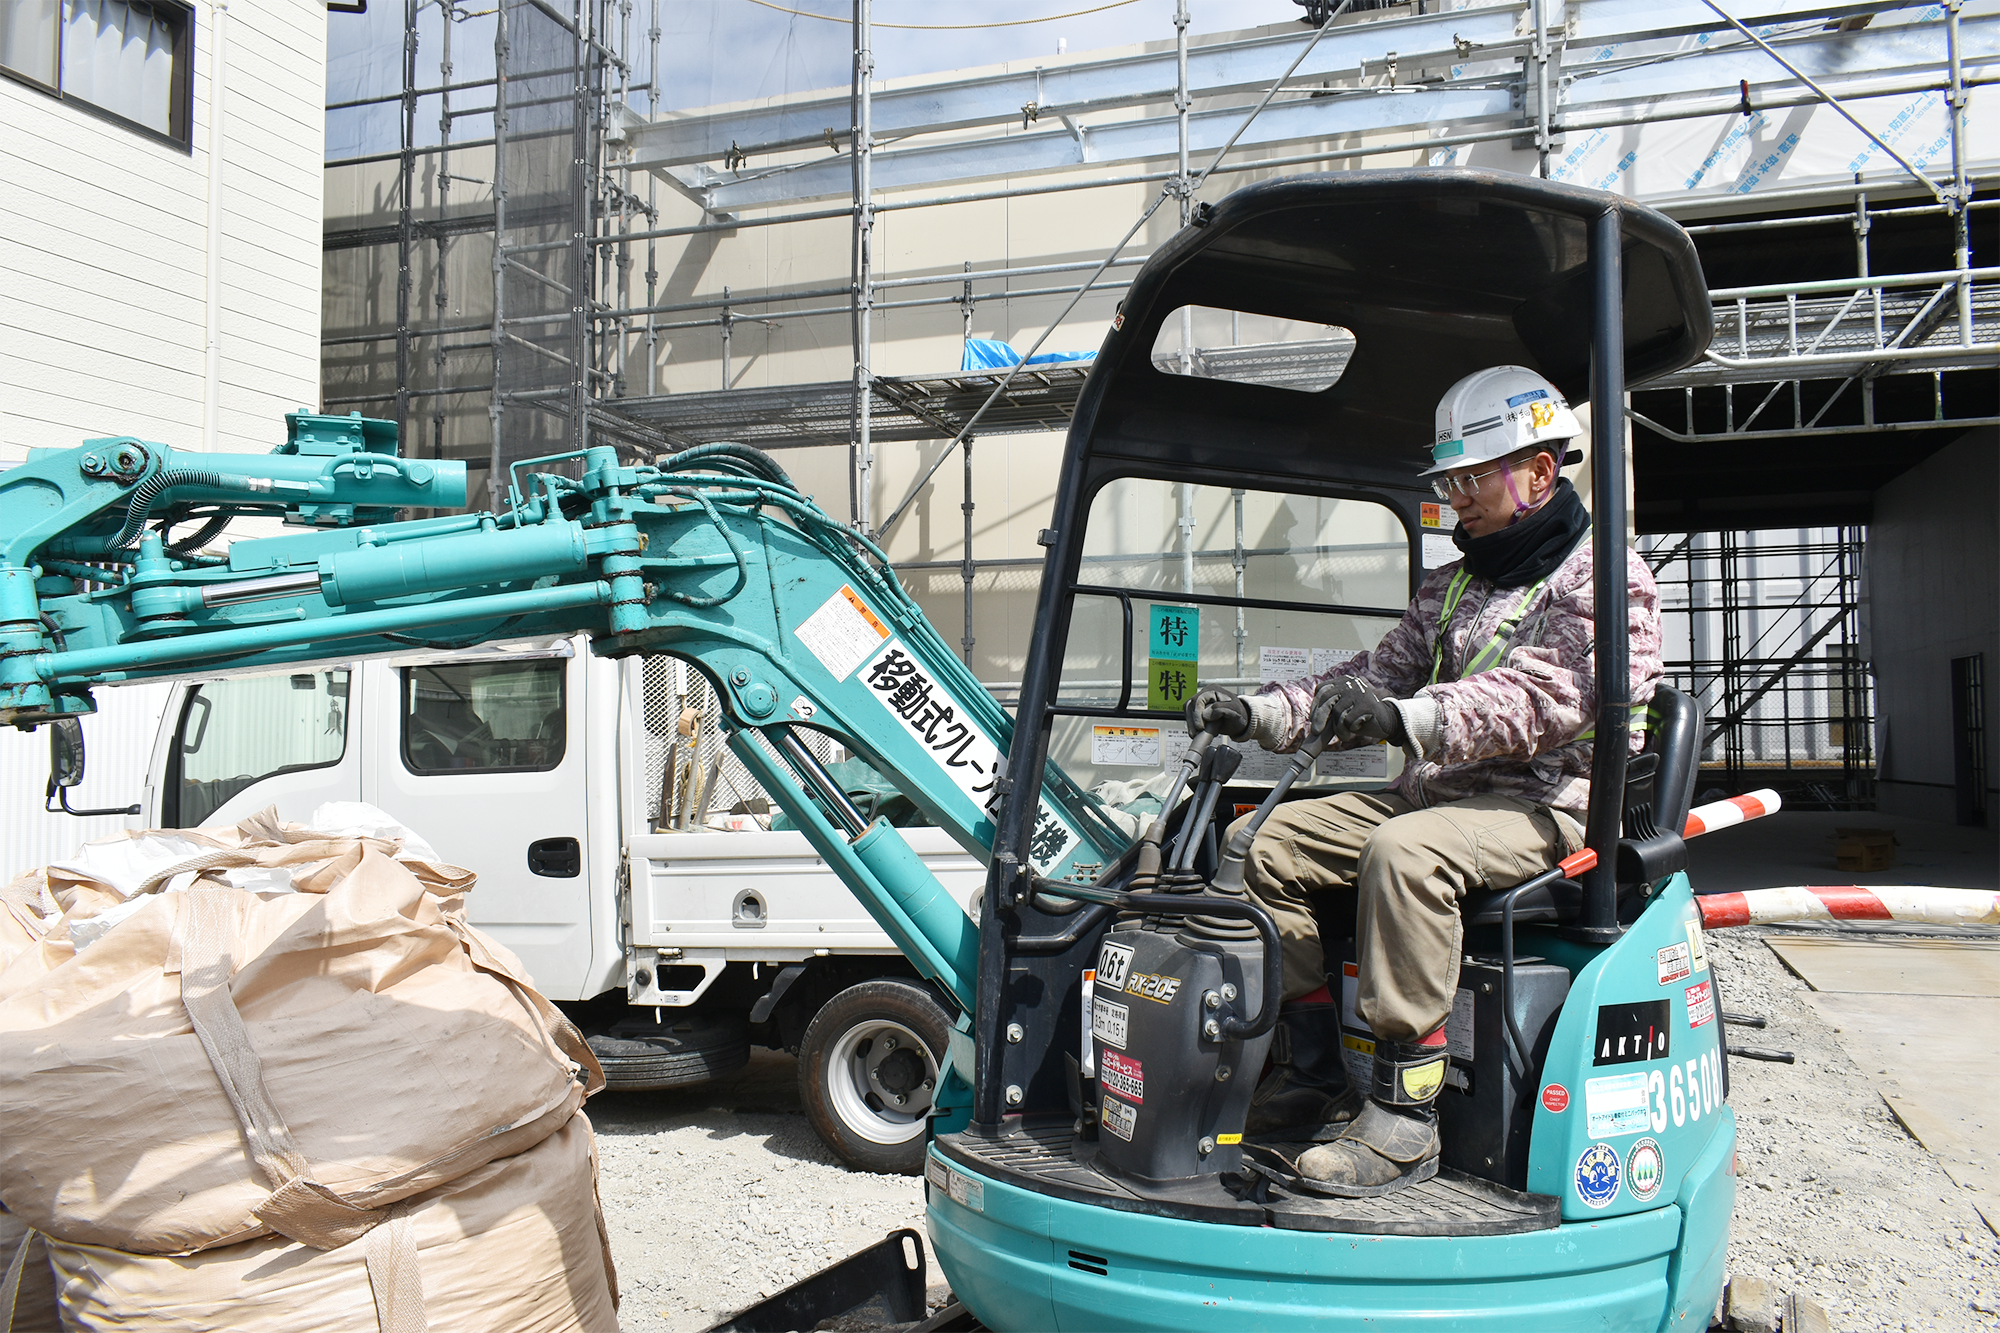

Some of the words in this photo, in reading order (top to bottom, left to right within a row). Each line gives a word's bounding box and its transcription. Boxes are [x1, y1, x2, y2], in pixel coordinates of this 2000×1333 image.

[1438, 431, 1452, 442] HSN
[1160, 615, 1189, 647] 特
[1159, 670, 1187, 701] 特
[1126, 972, 1182, 1002] RX-205
[1601, 1025, 1666, 1061] AKTIO
